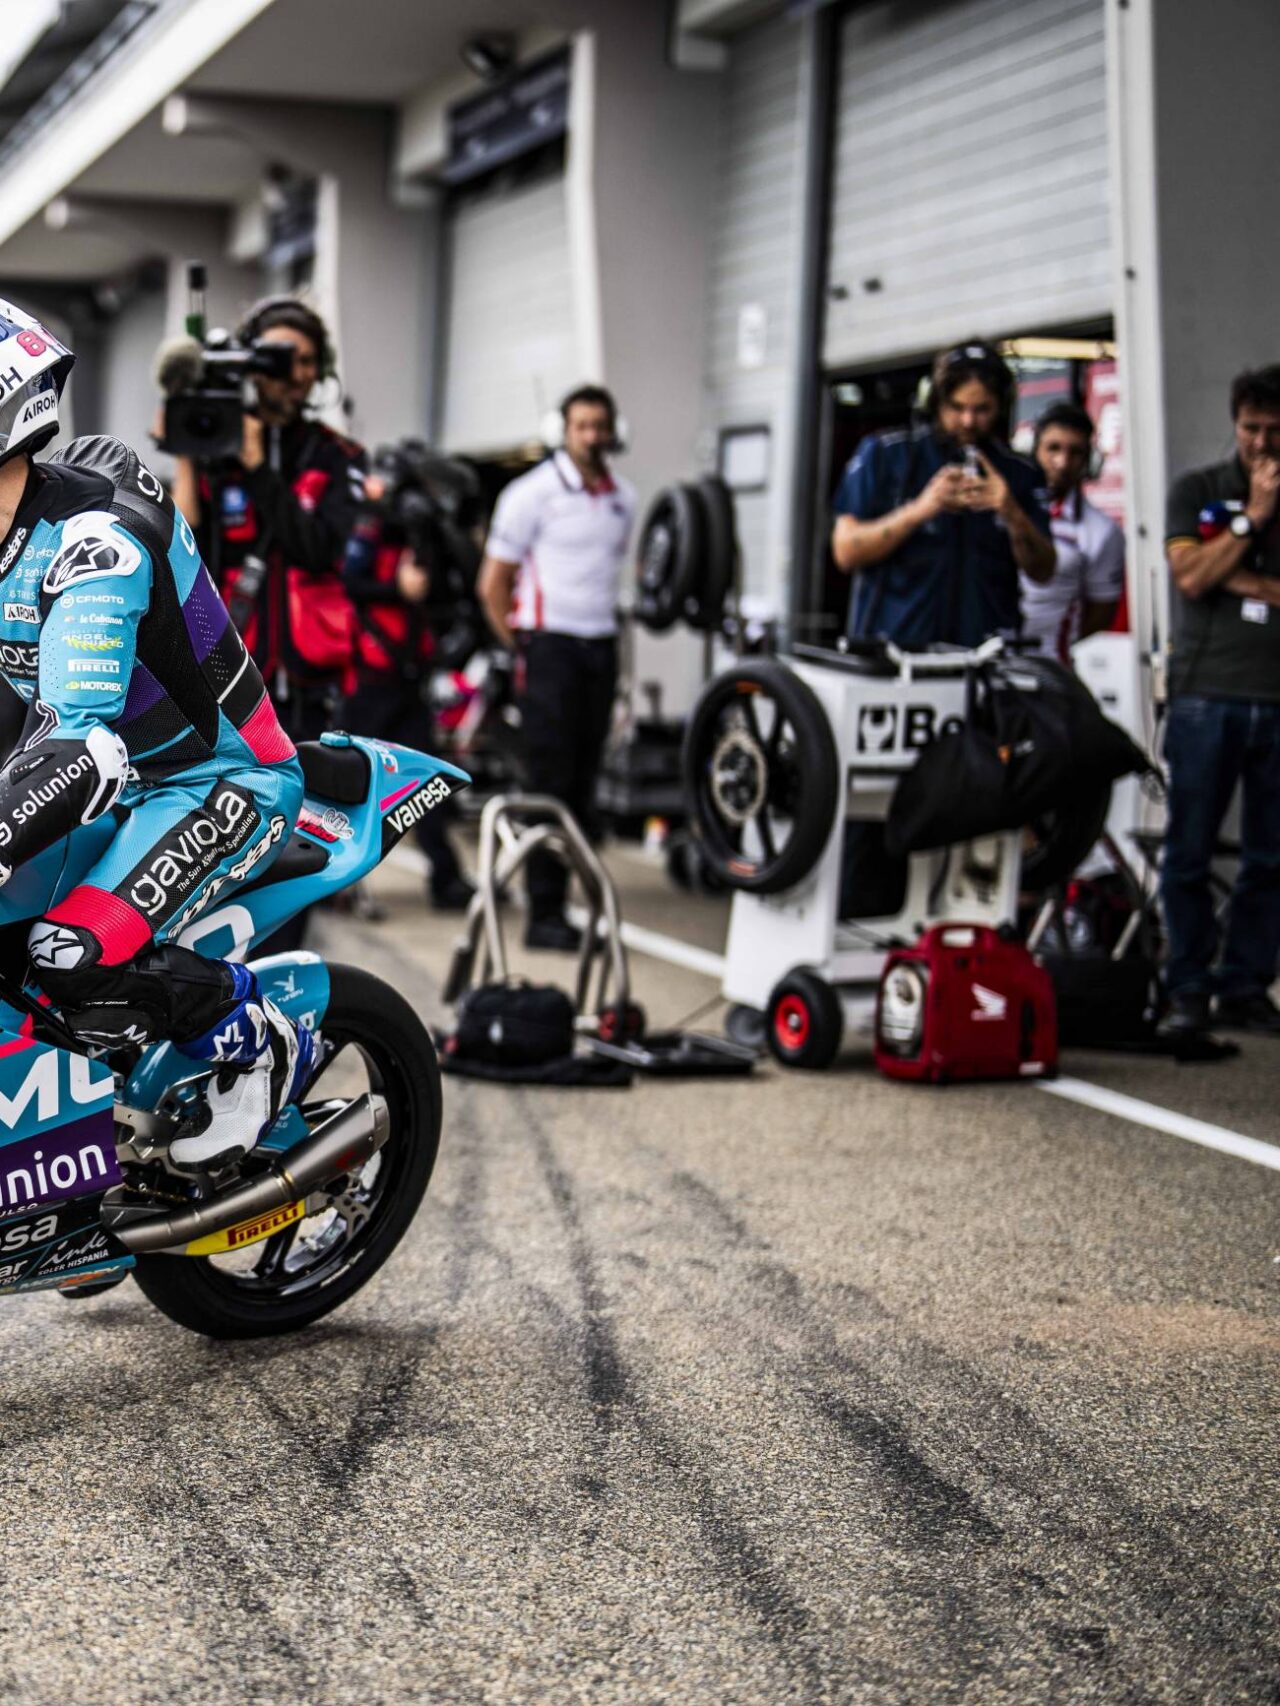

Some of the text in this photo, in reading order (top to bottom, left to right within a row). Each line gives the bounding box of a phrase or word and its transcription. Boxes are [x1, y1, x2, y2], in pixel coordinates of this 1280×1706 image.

[23, 395, 55, 423] AIROH
[76, 595, 124, 604] CFMOTO
[8, 606, 36, 621] AIROH
[68, 660, 120, 673] PIRELLI
[81, 681, 122, 692] MOTOREX
[12, 755, 94, 825] solunion
[387, 776, 451, 834] valresa
[226, 811, 256, 849] Specialists
[227, 1201, 299, 1247] PIRELLI
[38, 1249, 110, 1276] SOLER HISPANIA
